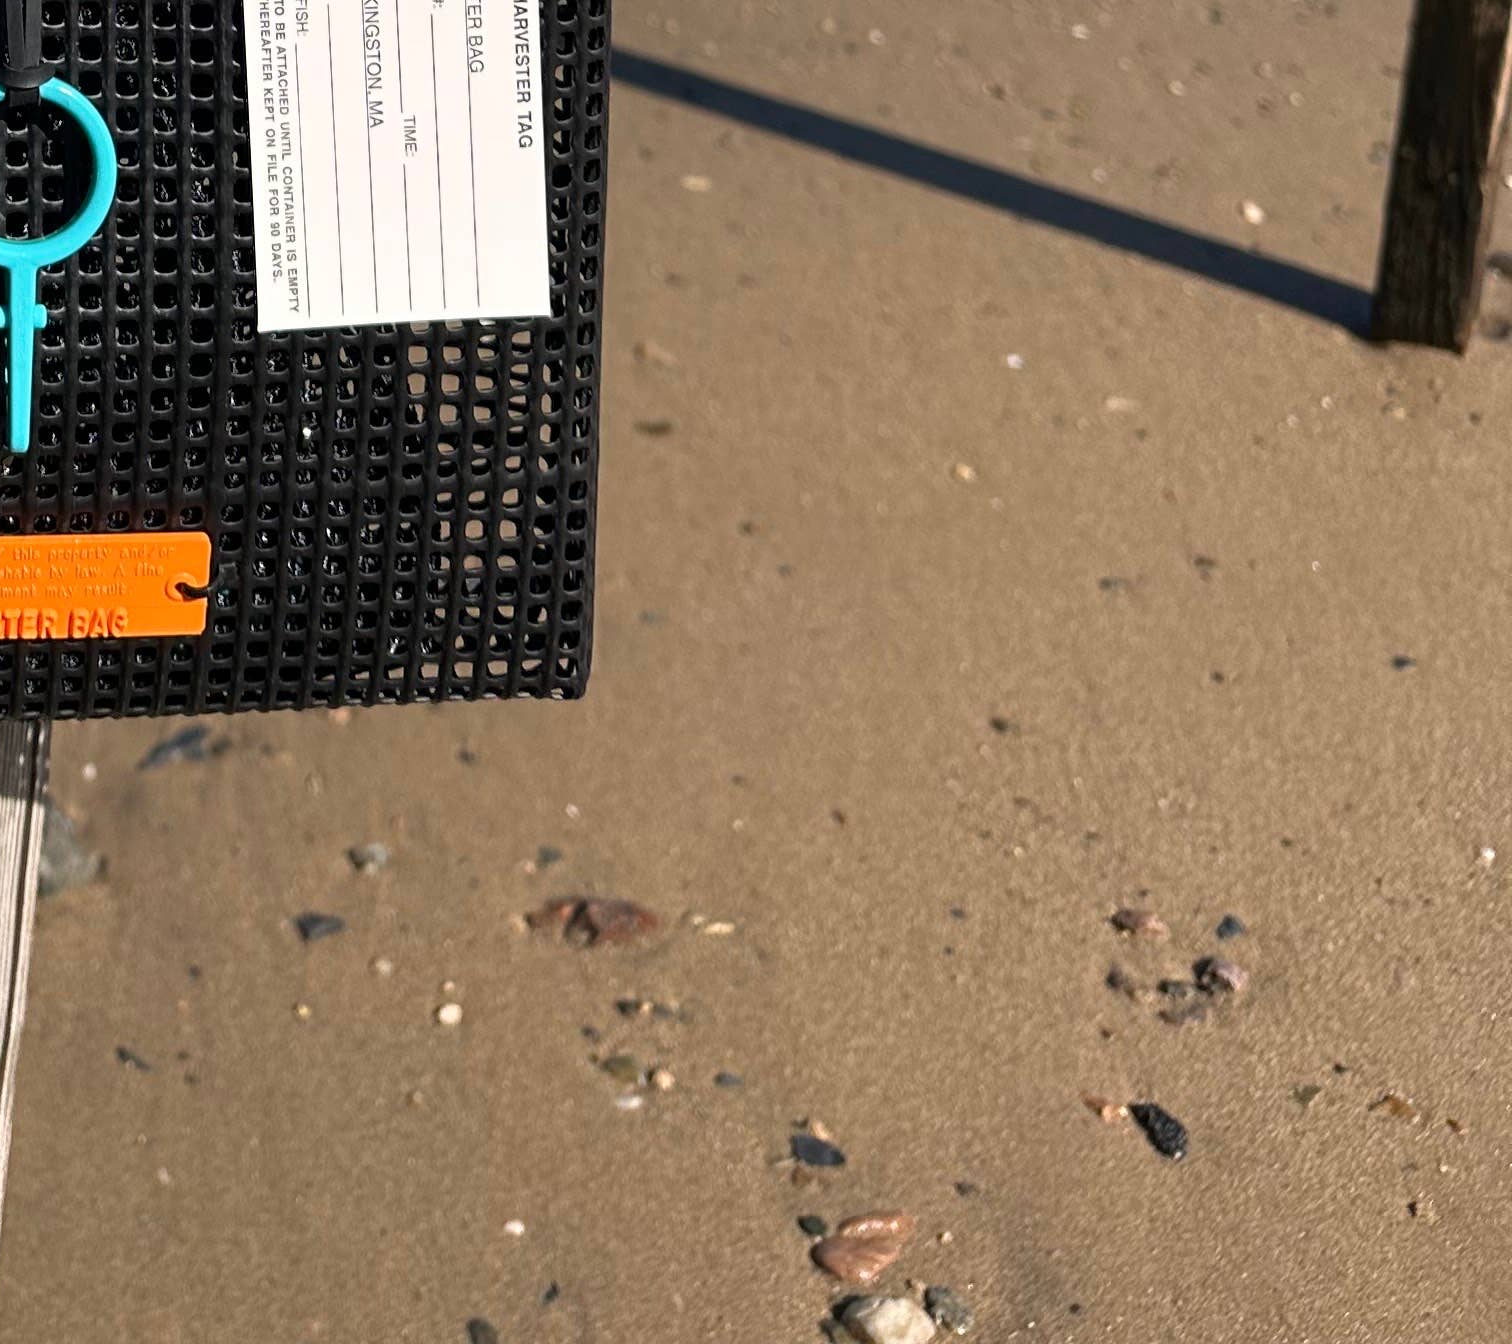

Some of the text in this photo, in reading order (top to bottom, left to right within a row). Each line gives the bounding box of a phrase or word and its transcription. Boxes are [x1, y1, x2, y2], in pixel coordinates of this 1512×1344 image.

[275, 22, 286, 40] BE
[468, 35, 485, 74] BAG
[276, 45, 290, 115] ATTACHED
[263, 88, 275, 122] KEPT
[369, 100, 384, 129] MA
[265, 128, 276, 148] ON
[280, 121, 292, 161] UNTIL
[403, 114, 417, 157] TIME:
[517, 110, 533, 149] TAG
[267, 154, 278, 183] FILE
[268, 188, 280, 216] FOR
[282, 166, 296, 243] CONTAINER
[270, 222, 281, 237] 90
[271, 243, 283, 283] DAYS.
[286, 249, 297, 262] IS
[287, 268, 300, 313] EMPTY
[13, 545, 41, 561] this
[48, 544, 112, 563] property
[119, 543, 175, 560] and/or
[49, 563, 69, 580] by
[113, 562, 125, 577] A
[135, 561, 165, 577] fine
[45, 585, 73, 599] may
[68, 606, 129, 639] BAG
